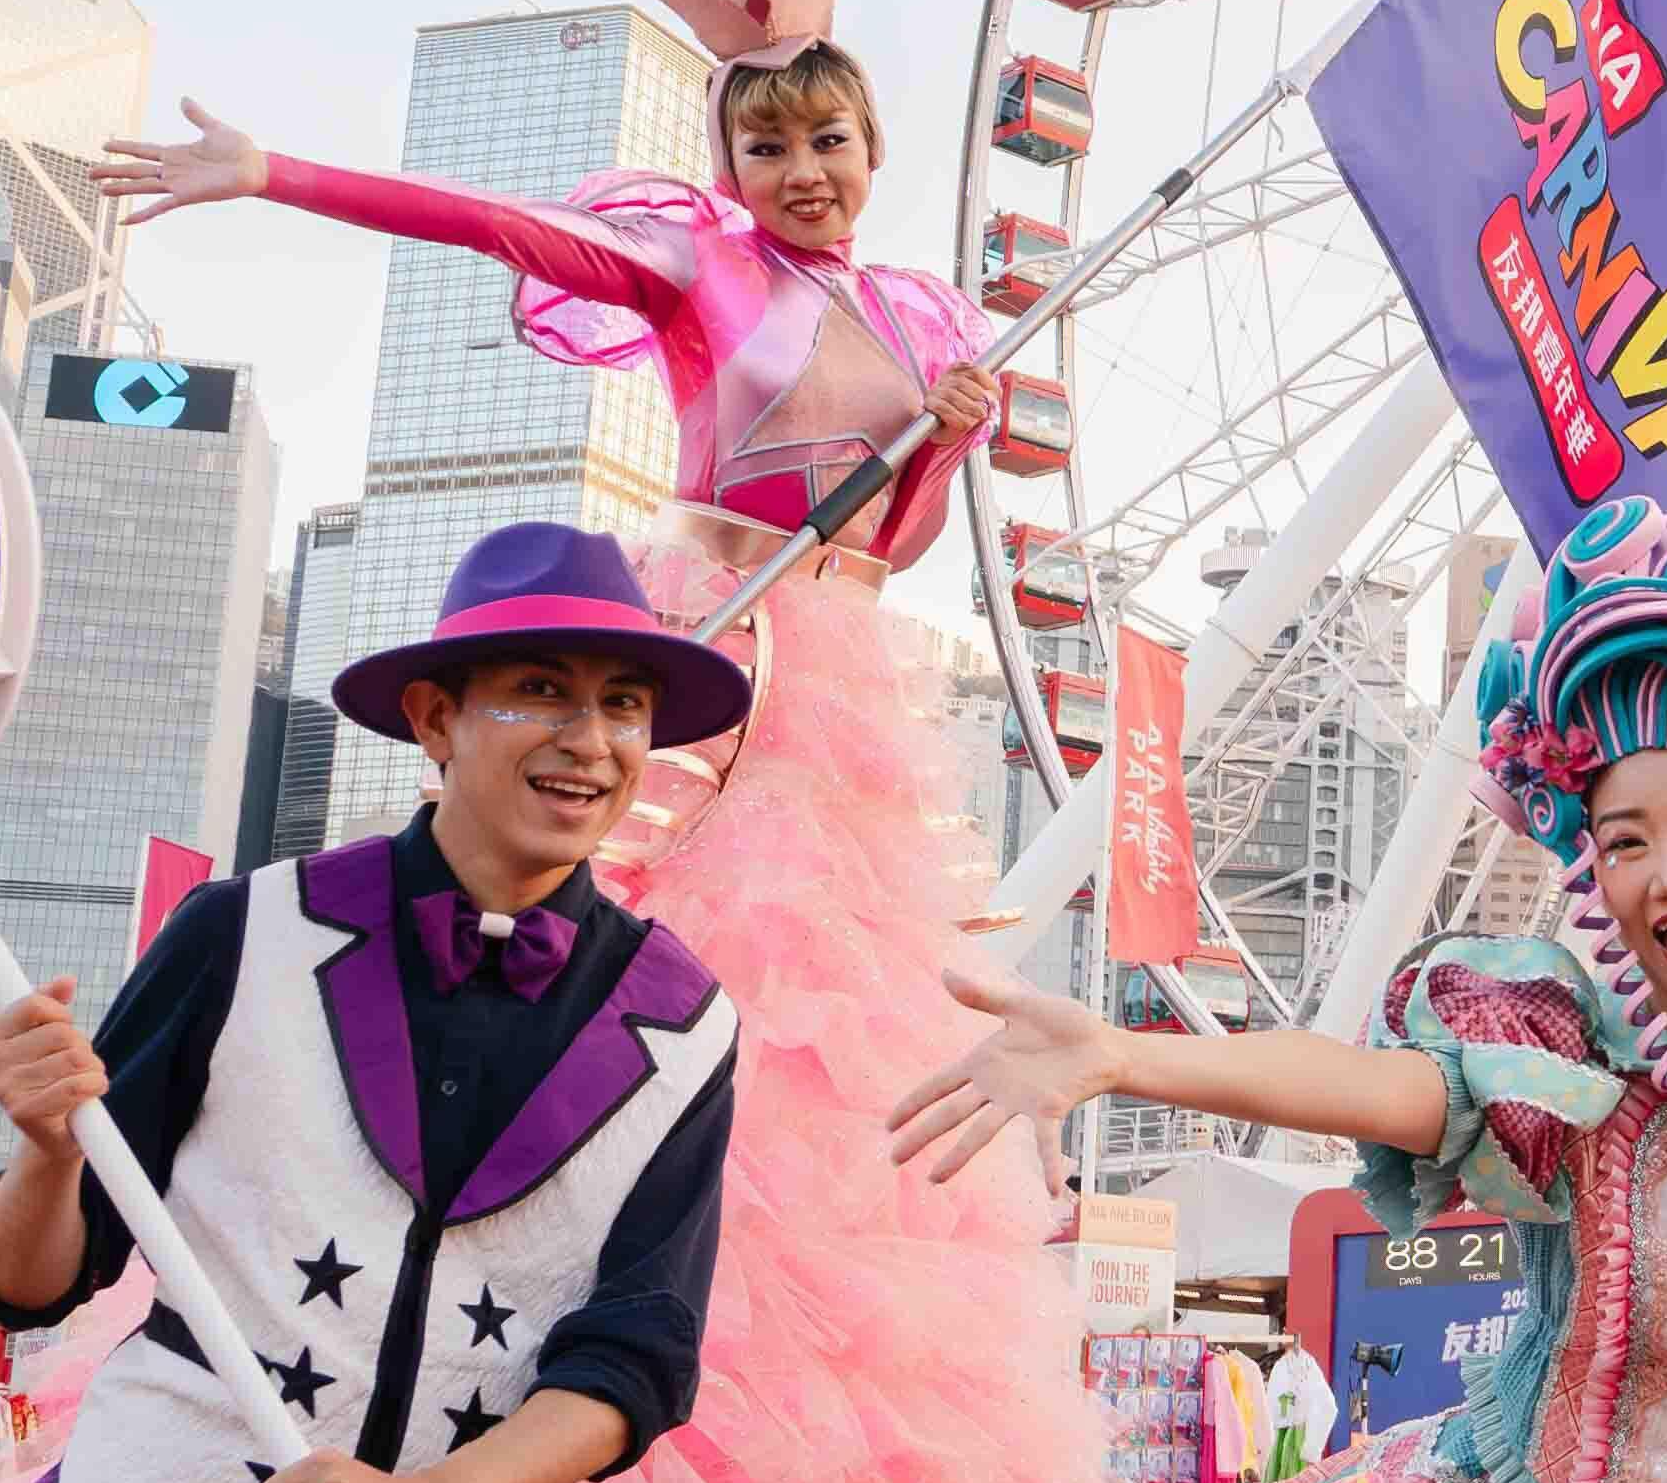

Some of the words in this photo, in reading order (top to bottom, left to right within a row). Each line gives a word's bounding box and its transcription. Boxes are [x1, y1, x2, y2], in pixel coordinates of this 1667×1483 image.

[1492, 232, 1598, 467] 友邦嘉年華
[1148, 718, 1166, 794] AIA
[1120, 727, 1146, 845] PARK
[1385, 1236, 1437, 1271] 88
[1459, 1232, 1505, 1267] 21
[1123, 1261, 1150, 1285] THE
[1399, 1276, 1422, 1286] DAYS
[1468, 1271, 1501, 1282] HOURS
[1501, 1288, 1529, 1310] 202
[1442, 1317, 1514, 1362] 友邦
